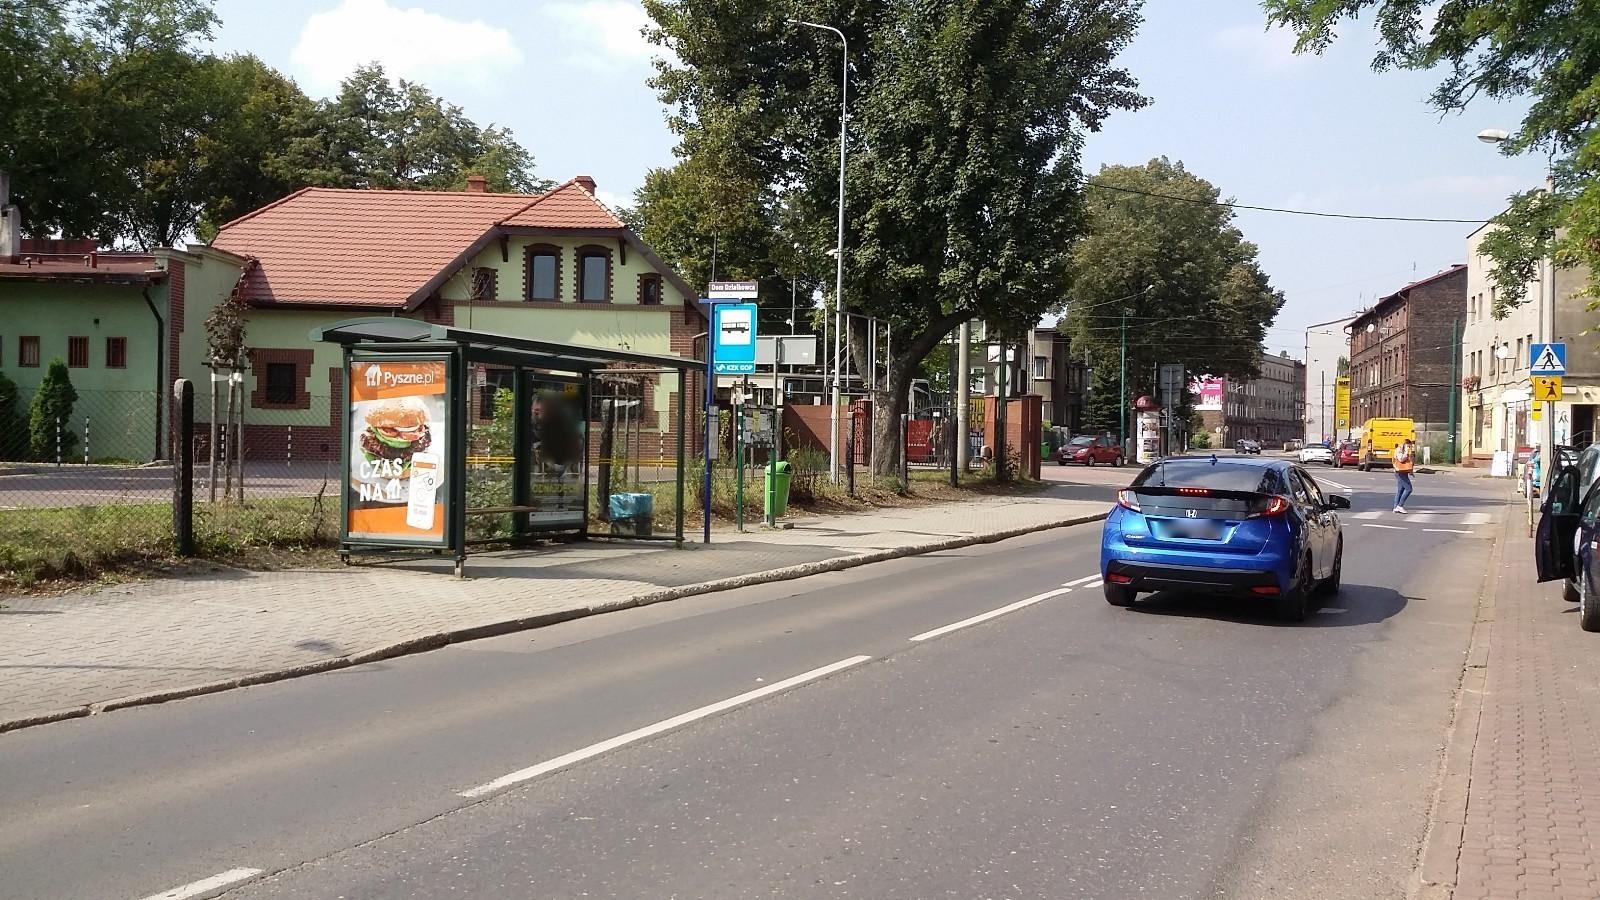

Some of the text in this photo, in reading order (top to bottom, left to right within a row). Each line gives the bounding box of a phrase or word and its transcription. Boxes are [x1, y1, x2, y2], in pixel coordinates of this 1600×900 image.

[384, 370, 434, 387] Pyszne.pl
[359, 457, 403, 479] CZAS
[359, 482, 384, 502] NA
